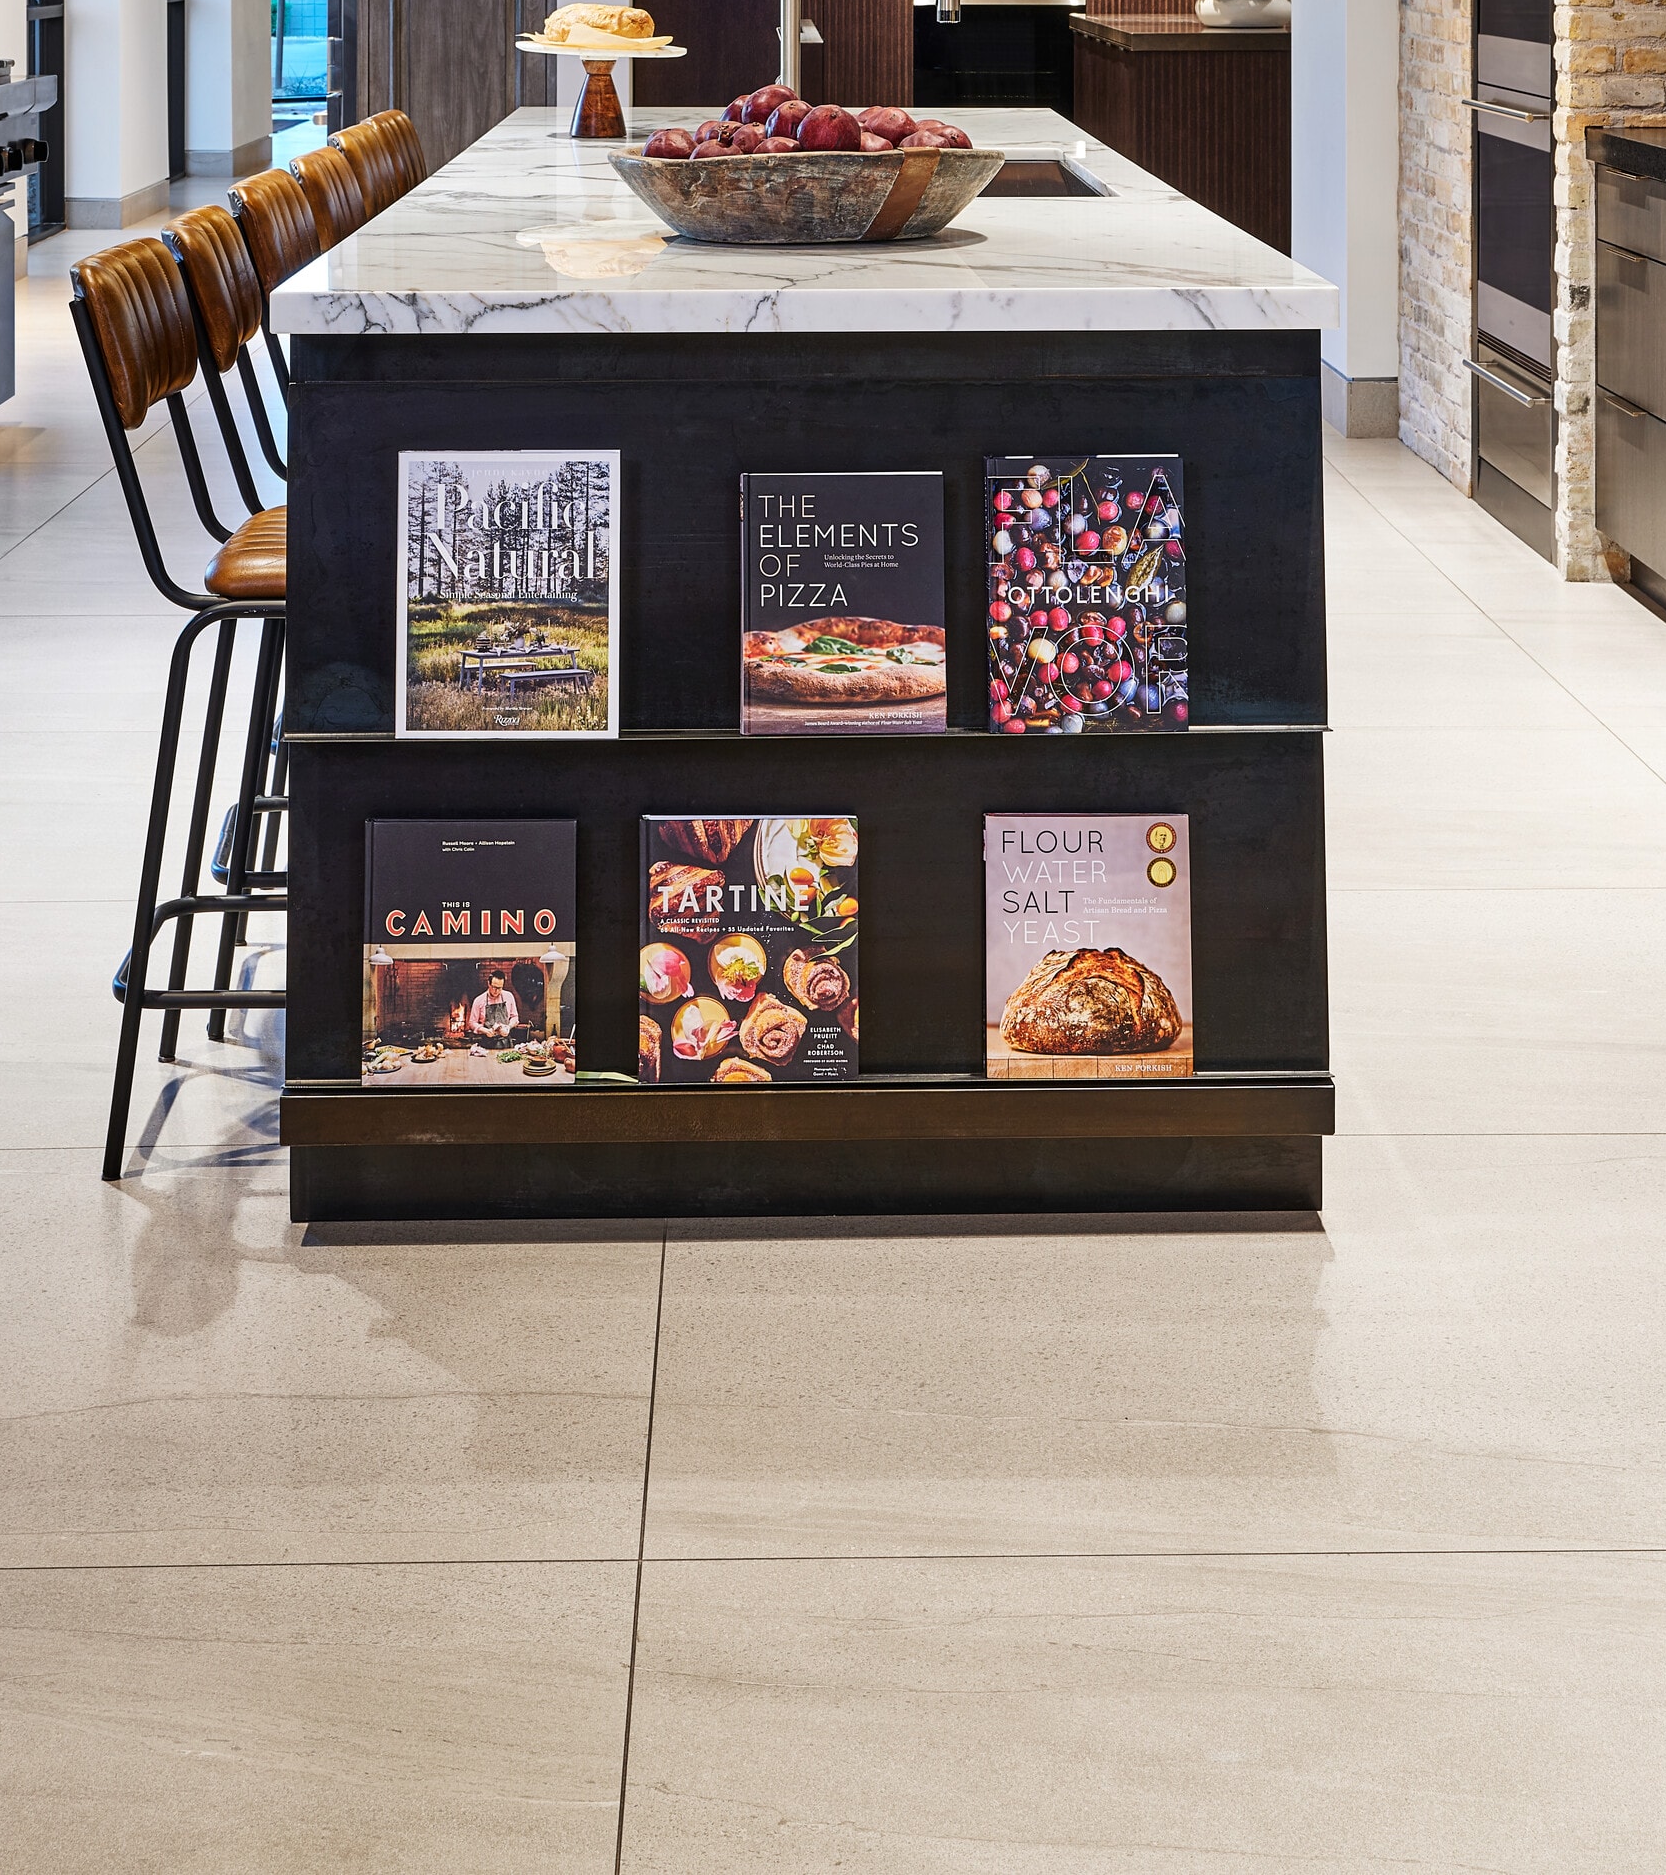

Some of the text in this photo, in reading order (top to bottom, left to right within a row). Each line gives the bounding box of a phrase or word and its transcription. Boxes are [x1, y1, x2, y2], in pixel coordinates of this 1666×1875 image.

[436, 481, 586, 531] Pacific
[757, 494, 816, 518] THE
[760, 523, 919, 548] ELEMENTS
[424, 530, 601, 580] Natural
[759, 554, 801, 577] OF
[823, 553, 855, 562] Unlocking
[439, 588, 578, 602] Simple Seasonal Entertaining
[761, 583, 848, 607] PIZZA
[1008, 585, 1171, 605] OTTOLENGHI
[887, 711, 923, 719] FORKISH
[1002, 830, 1104, 854] FLOUR
[1002, 860, 1107, 884] WATER
[657, 884, 810, 913] TARTINE
[1002, 890, 1075, 914] SALT
[1082, 896, 1158, 905] The Fundamentals of
[1083, 906, 1168, 914] Artisan Bread and Pizza
[385, 908, 557, 937] CAMINO
[696, 926, 720, 934] Recipes
[1003, 920, 1101, 944] YEAST
[1115, 1064, 1172, 1072] KEN FORKISH
